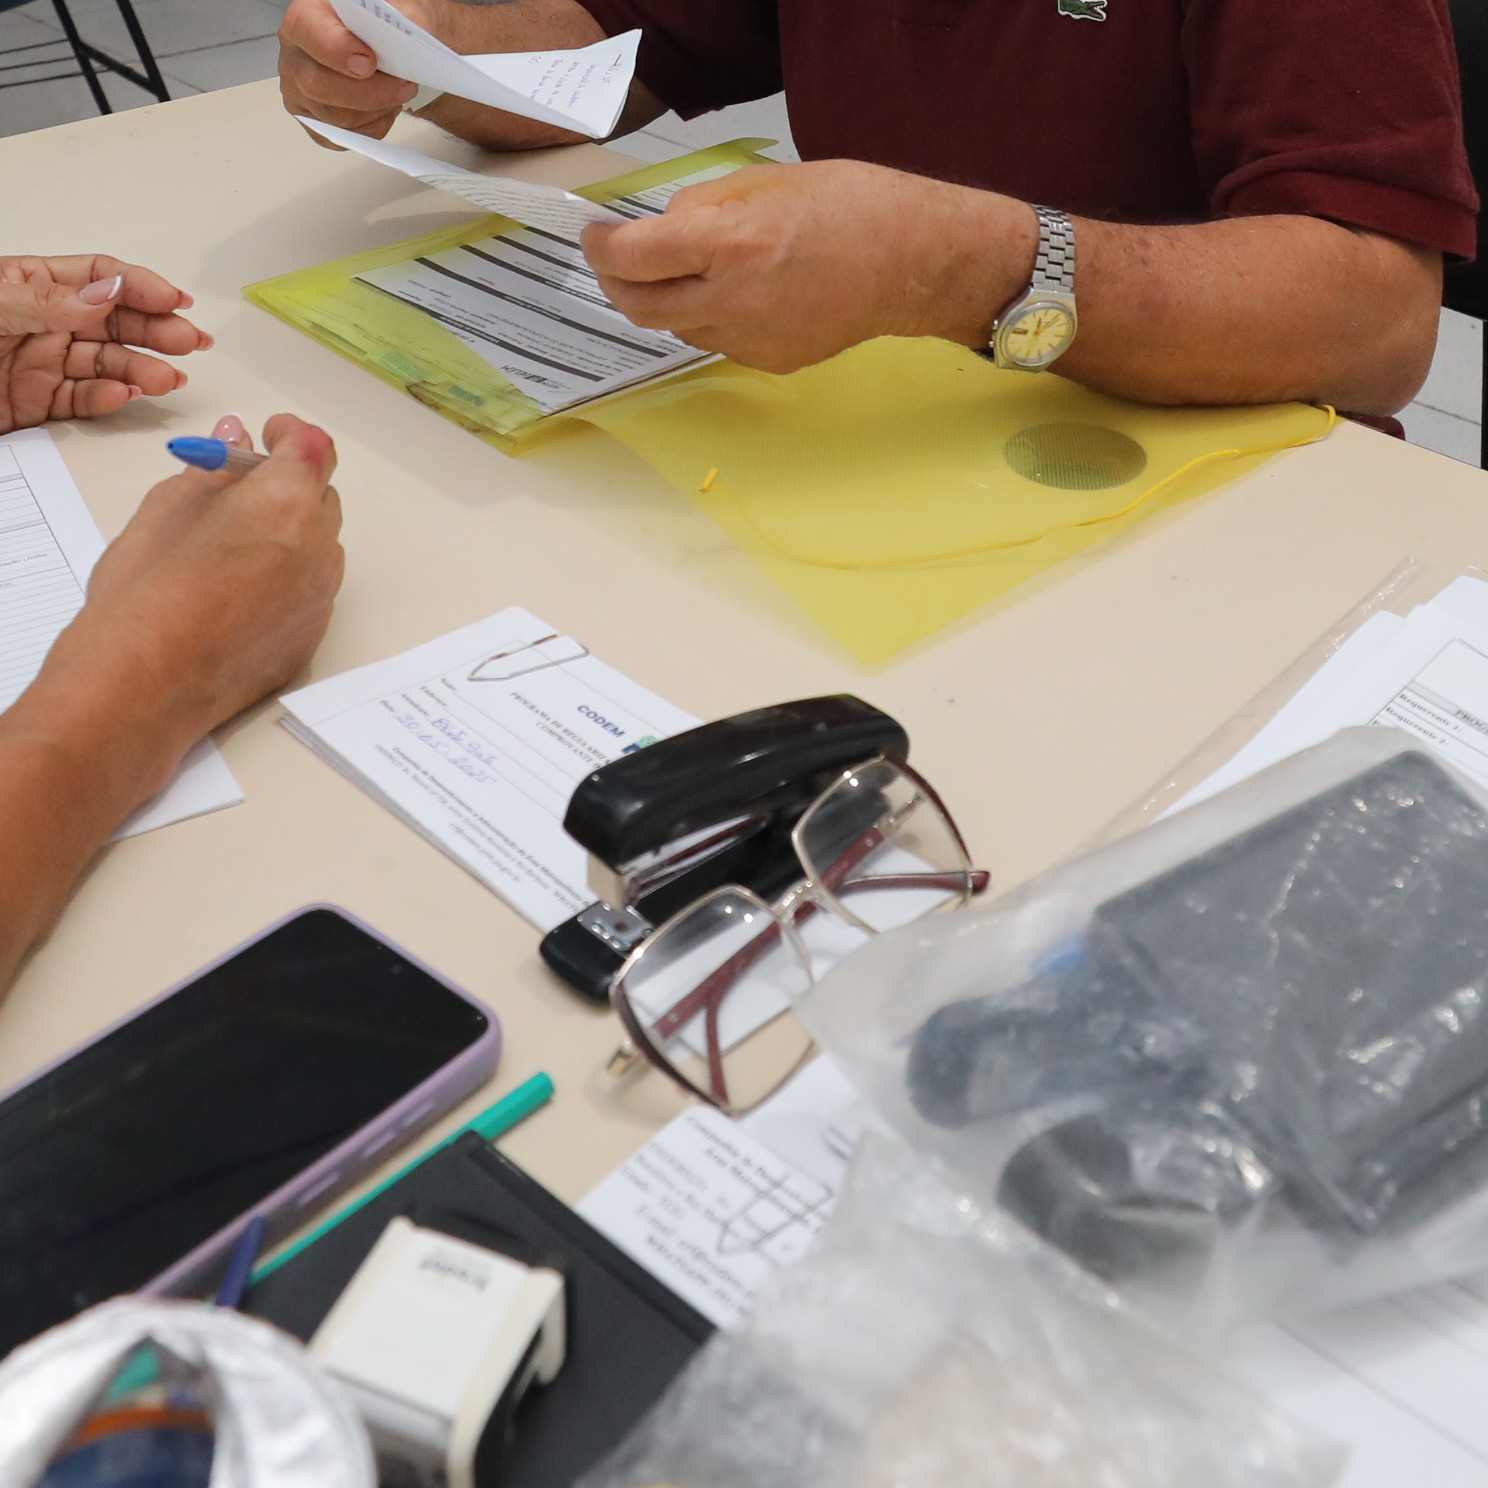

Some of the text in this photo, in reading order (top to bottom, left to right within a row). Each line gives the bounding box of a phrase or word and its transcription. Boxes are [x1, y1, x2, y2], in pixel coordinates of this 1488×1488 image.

[510, 691, 551, 723] PROGRAMA
[576, 705, 626, 739] CODEM
[1385, 706, 1439, 742] Requerente
[1399, 692, 1452, 729] Requerente
